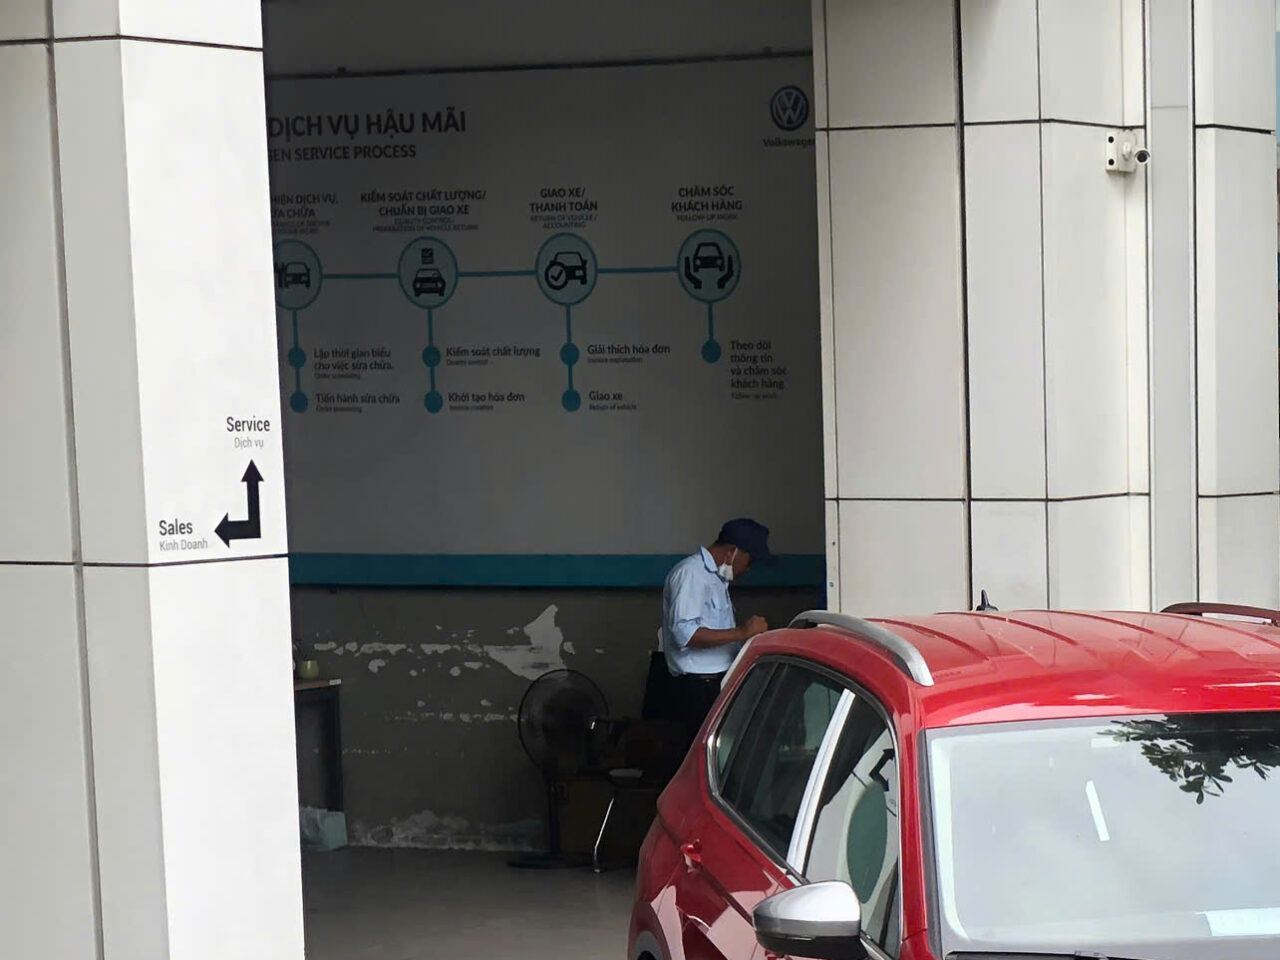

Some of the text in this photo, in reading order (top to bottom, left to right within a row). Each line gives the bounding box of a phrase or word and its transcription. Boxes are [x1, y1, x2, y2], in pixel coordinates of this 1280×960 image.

[268, 106, 466, 142] DỊCH VỤ HẬU MÃI
[295, 145, 350, 161] SERVICE
[353, 144, 416, 159] PROCESS
[540, 188, 566, 198] GIAO
[712, 184, 735, 196] SÓC
[429, 205, 455, 216] GIAO
[456, 204, 470, 215] XE
[529, 198, 598, 213] THANH TOÁN
[671, 199, 743, 212] KHÁCH HÀNG
[607, 344, 630, 354] thích
[652, 343, 671, 354] đơn
[730, 341, 754, 350] Theo
[507, 391, 525, 402] đơn
[589, 391, 623, 401] Giao xe
[226, 415, 271, 432] Service
[234, 436, 264, 449] Dịch vụ
[159, 518, 193, 536] Sales
[159, 537, 208, 552] Kinh Doanh
